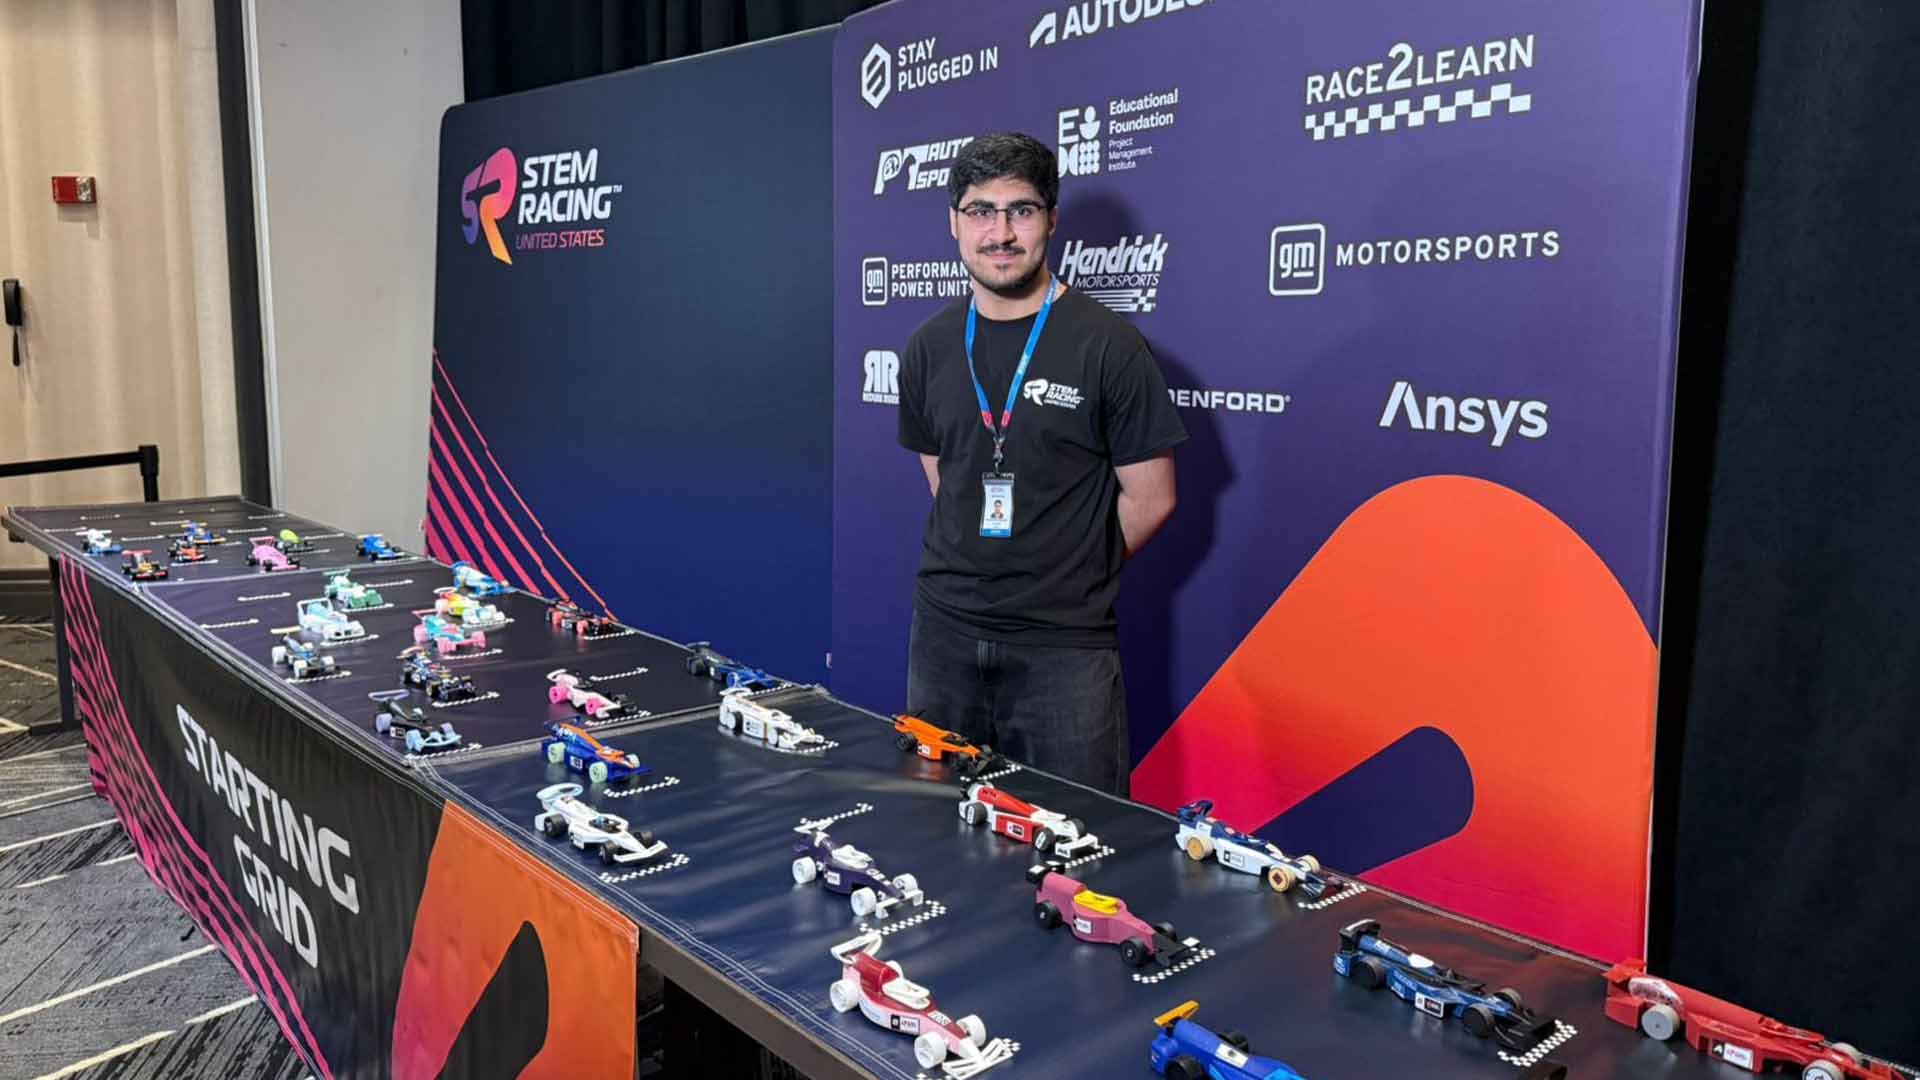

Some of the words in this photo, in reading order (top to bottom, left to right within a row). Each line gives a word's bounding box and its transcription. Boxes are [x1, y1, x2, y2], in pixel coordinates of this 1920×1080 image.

[898, 38, 936, 67] STAY
[898, 53, 973, 91] PLUGGED
[979, 47, 998, 71] IN
[1306, 35, 1534, 104] RACE2LEARN
[1109, 88, 1178, 115] Educational
[1109, 112, 1174, 135] Foundation
[1108, 138, 1134, 149] Project
[1108, 146, 1153, 160] Management
[521, 148, 598, 189] STEM
[916, 168, 950, 190] SPO
[515, 232, 558, 250] UNITED
[559, 229, 605, 248] STATES
[1336, 231, 1560, 267] MOTORSPORTS
[891, 261, 969, 279] PERFORMAN
[1058, 233, 1168, 287] Hendrick
[1279, 242, 1315, 278] gm
[866, 270, 884, 293] gm
[891, 282, 933, 298] POWER
[1075, 273, 1160, 288] MOTORSPORTS
[1167, 389, 1285, 413] ENFORD
[1379, 381, 1549, 447] Ansys
[176, 704, 360, 915] STARTING
[233, 834, 318, 968] GRID
